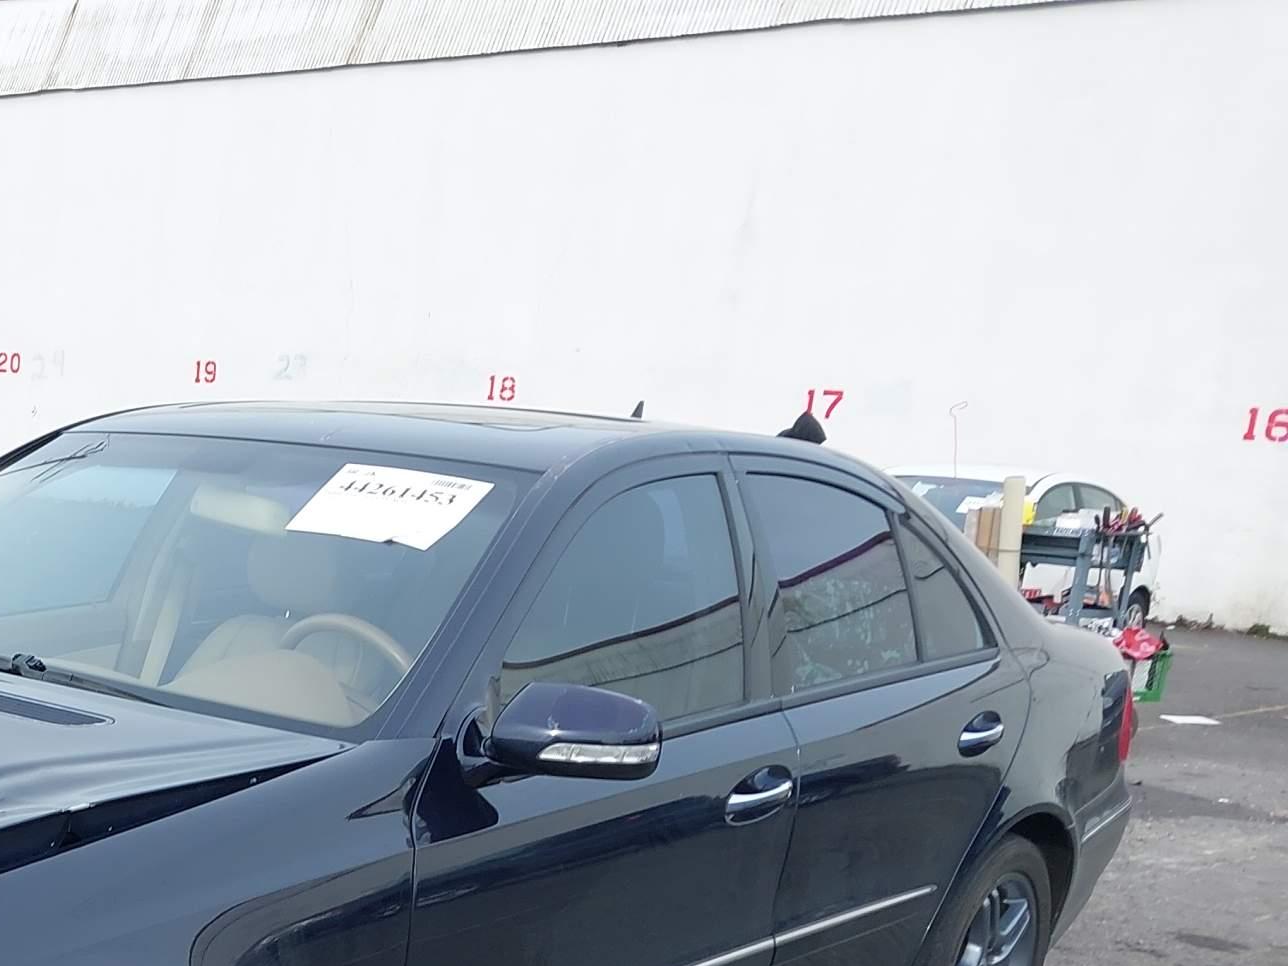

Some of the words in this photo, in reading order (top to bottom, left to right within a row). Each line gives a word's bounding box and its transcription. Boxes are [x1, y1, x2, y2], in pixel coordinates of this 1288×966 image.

[194, 360, 217, 384] 19
[487, 375, 515, 401] 18
[807, 389, 844, 419] 17
[1243, 407, 1288, 442] 16
[339, 480, 457, 504] 44261453
